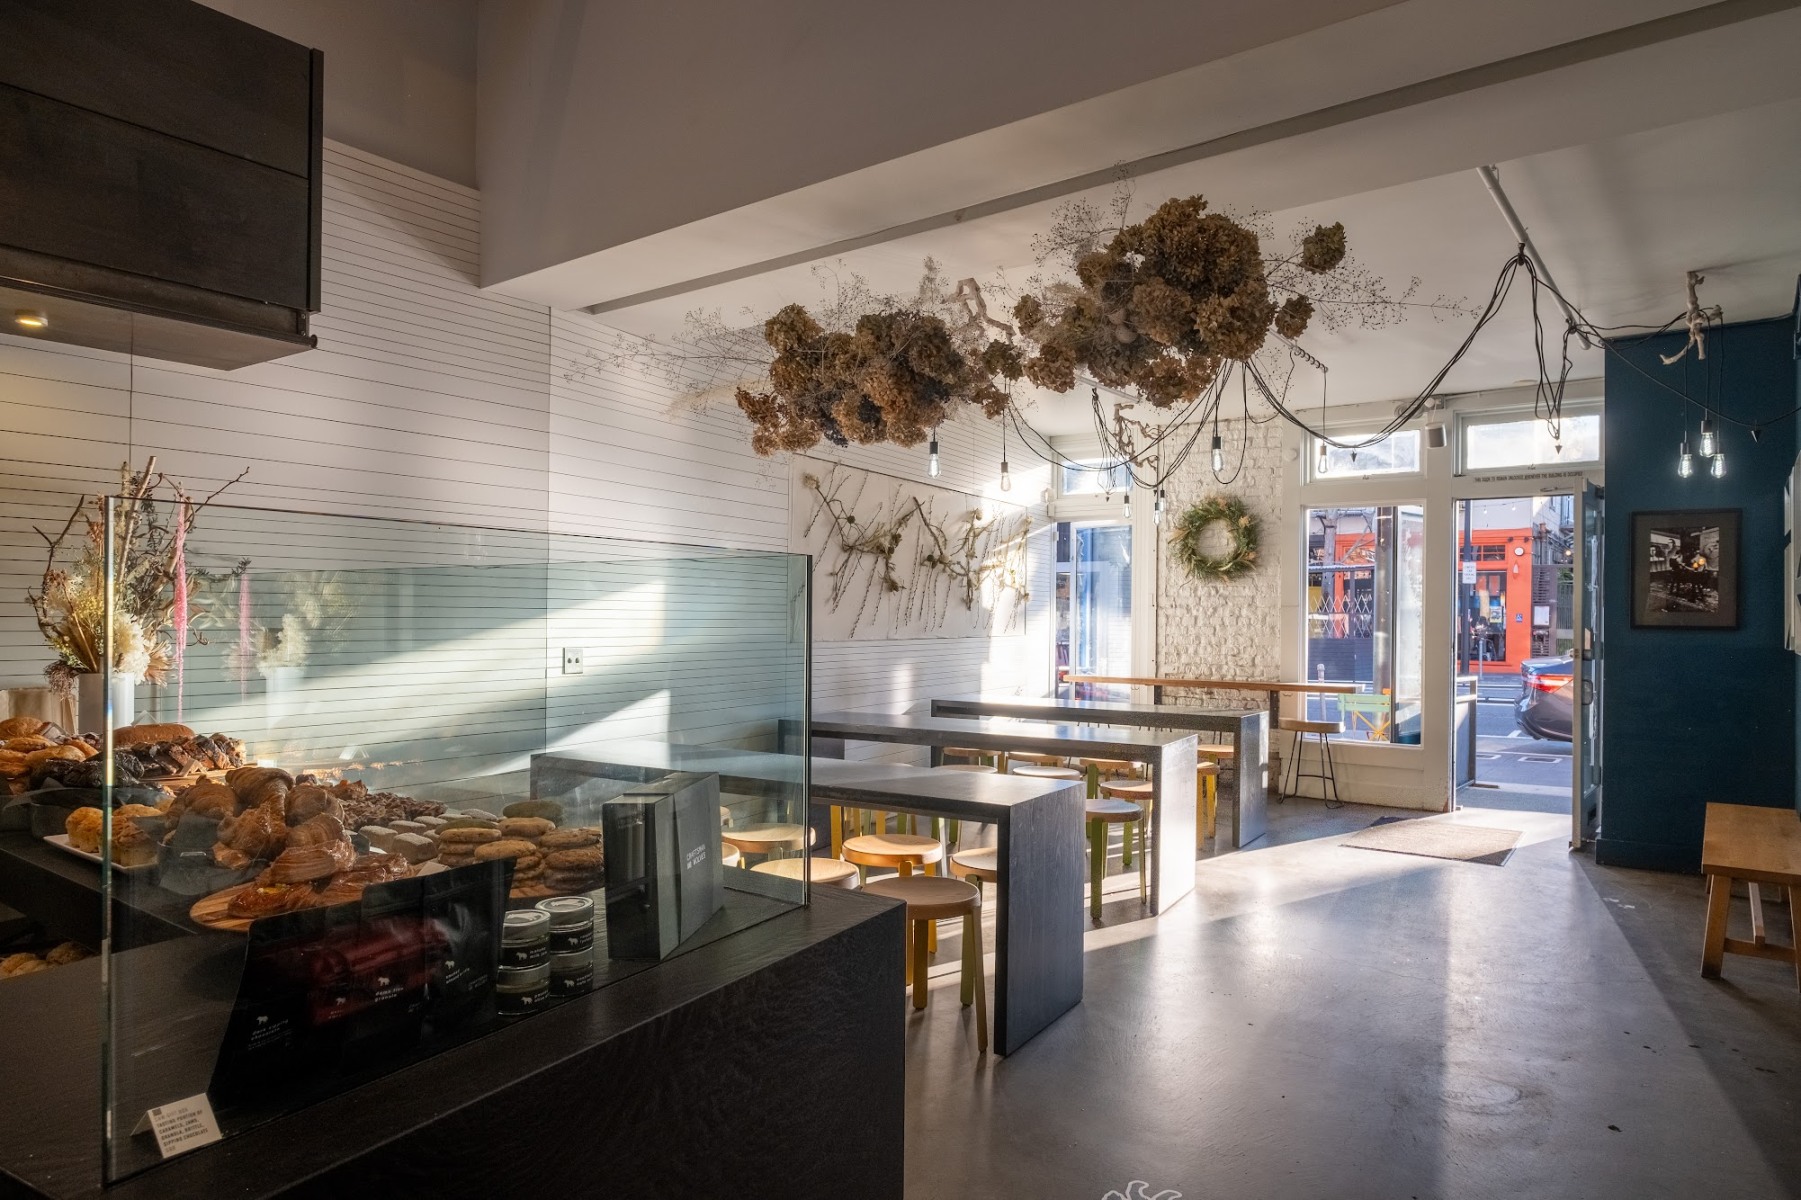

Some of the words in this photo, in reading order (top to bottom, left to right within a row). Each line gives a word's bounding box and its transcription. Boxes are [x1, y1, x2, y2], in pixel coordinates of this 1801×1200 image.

[693, 852, 706, 865] WOLVES
[157, 1118, 175, 1128] TASTING
[177, 1111, 196, 1121] PORTION
[159, 1122, 185, 1134] CARAMELS,
[185, 1118, 199, 1126] JAMS,
[161, 1130, 184, 1140] GRANOLA,
[184, 1122, 204, 1132] BRITTLE,
[163, 1136, 182, 1146] SIPPING
[183, 1127, 208, 1140] CHOCOLATE
